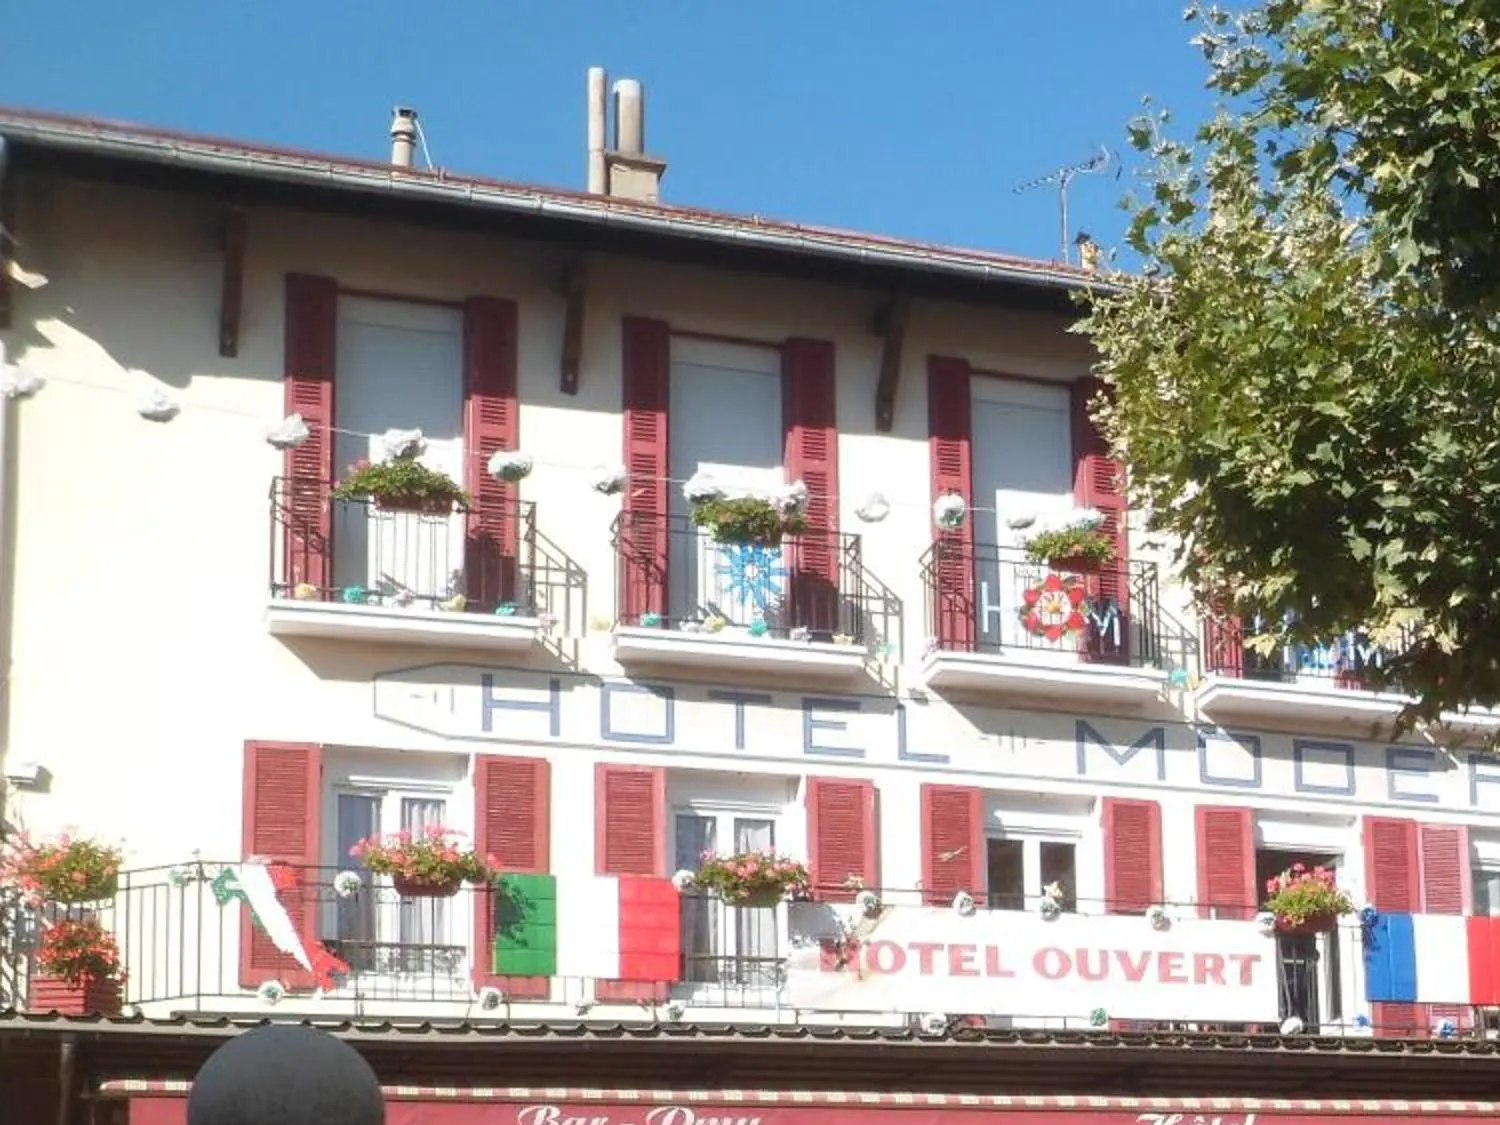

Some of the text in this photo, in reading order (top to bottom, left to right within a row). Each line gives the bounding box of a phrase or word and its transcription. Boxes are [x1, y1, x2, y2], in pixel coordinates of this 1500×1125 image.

[481, 673, 951, 764] HOTEL
[819, 937, 1263, 987] HOTEL OUVERT
